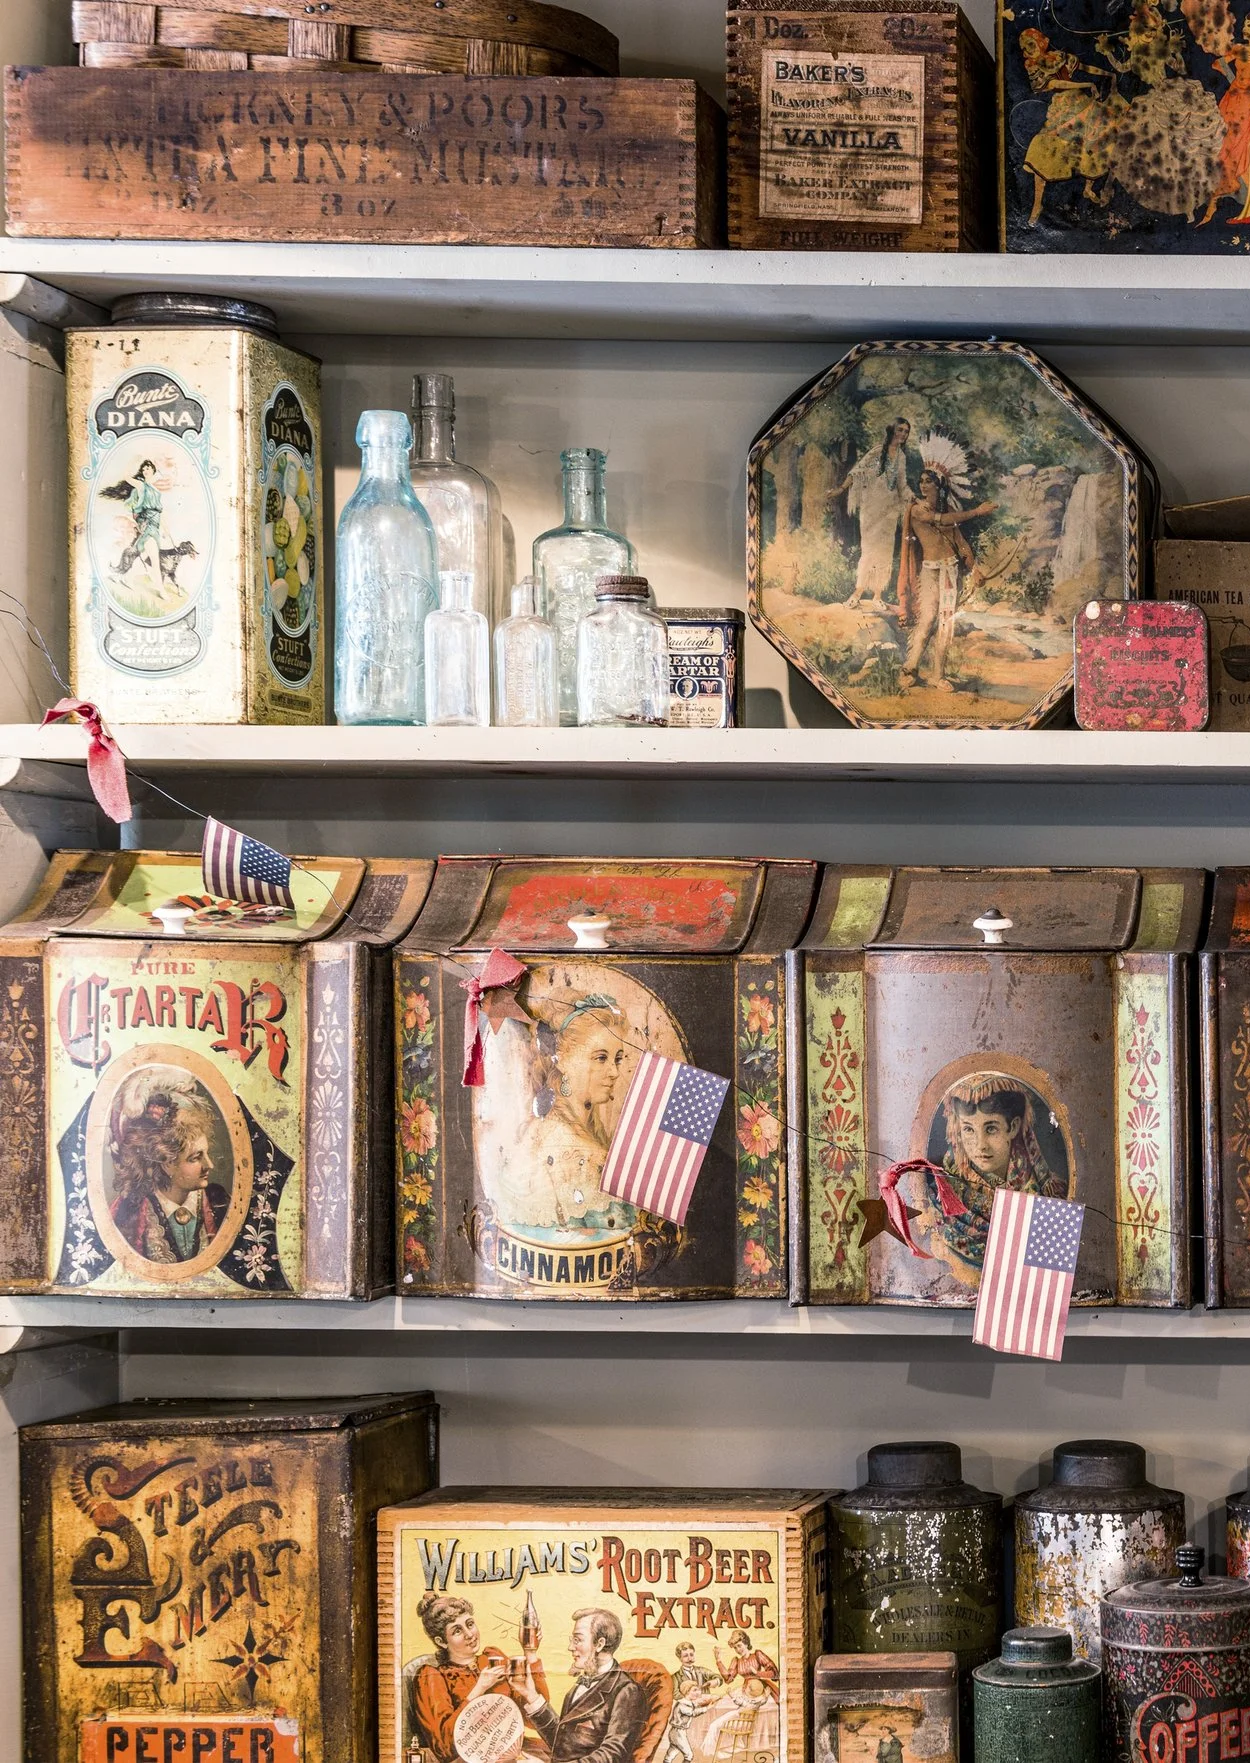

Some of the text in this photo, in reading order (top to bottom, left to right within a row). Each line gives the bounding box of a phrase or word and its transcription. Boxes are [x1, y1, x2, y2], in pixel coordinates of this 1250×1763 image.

[776, 61, 866, 84] BAKER'S
[130, 92, 604, 130] TICKNEY & POORS
[783, 128, 902, 150] VANILLA
[775, 174, 913, 191] BAKER EXTRACT
[321, 193, 343, 217] 3
[116, 383, 180, 409] Bunte
[108, 412, 196, 427] DIANA
[275, 398, 303, 420] Bunte
[271, 421, 310, 450] DIANA
[1168, 588, 1220, 604] AMERICAN
[1225, 590, 1244, 605] TEA
[109, 643, 199, 657] Confections
[272, 651, 311, 670] Confections
[704, 657, 720, 665] OF
[130, 961, 196, 976] PURE
[416, 1535, 774, 1605] WILLIAMS' ROOT BEER
[631, 1591, 776, 1640] EXTRACT.
[945, 1606, 953, 1616] &
[892, 1629, 970, 1643] DEALERS IN
[457, 1696, 505, 1748] ROOT BEER EXTRACT
[459, 1699, 488, 1731] NO OTHER
[106, 1726, 276, 1763] PEPPER
[464, 1733, 487, 1758] EQUALS
[480, 1729, 503, 1763] STRENGTH
[494, 1719, 518, 1756] AND PURITY
